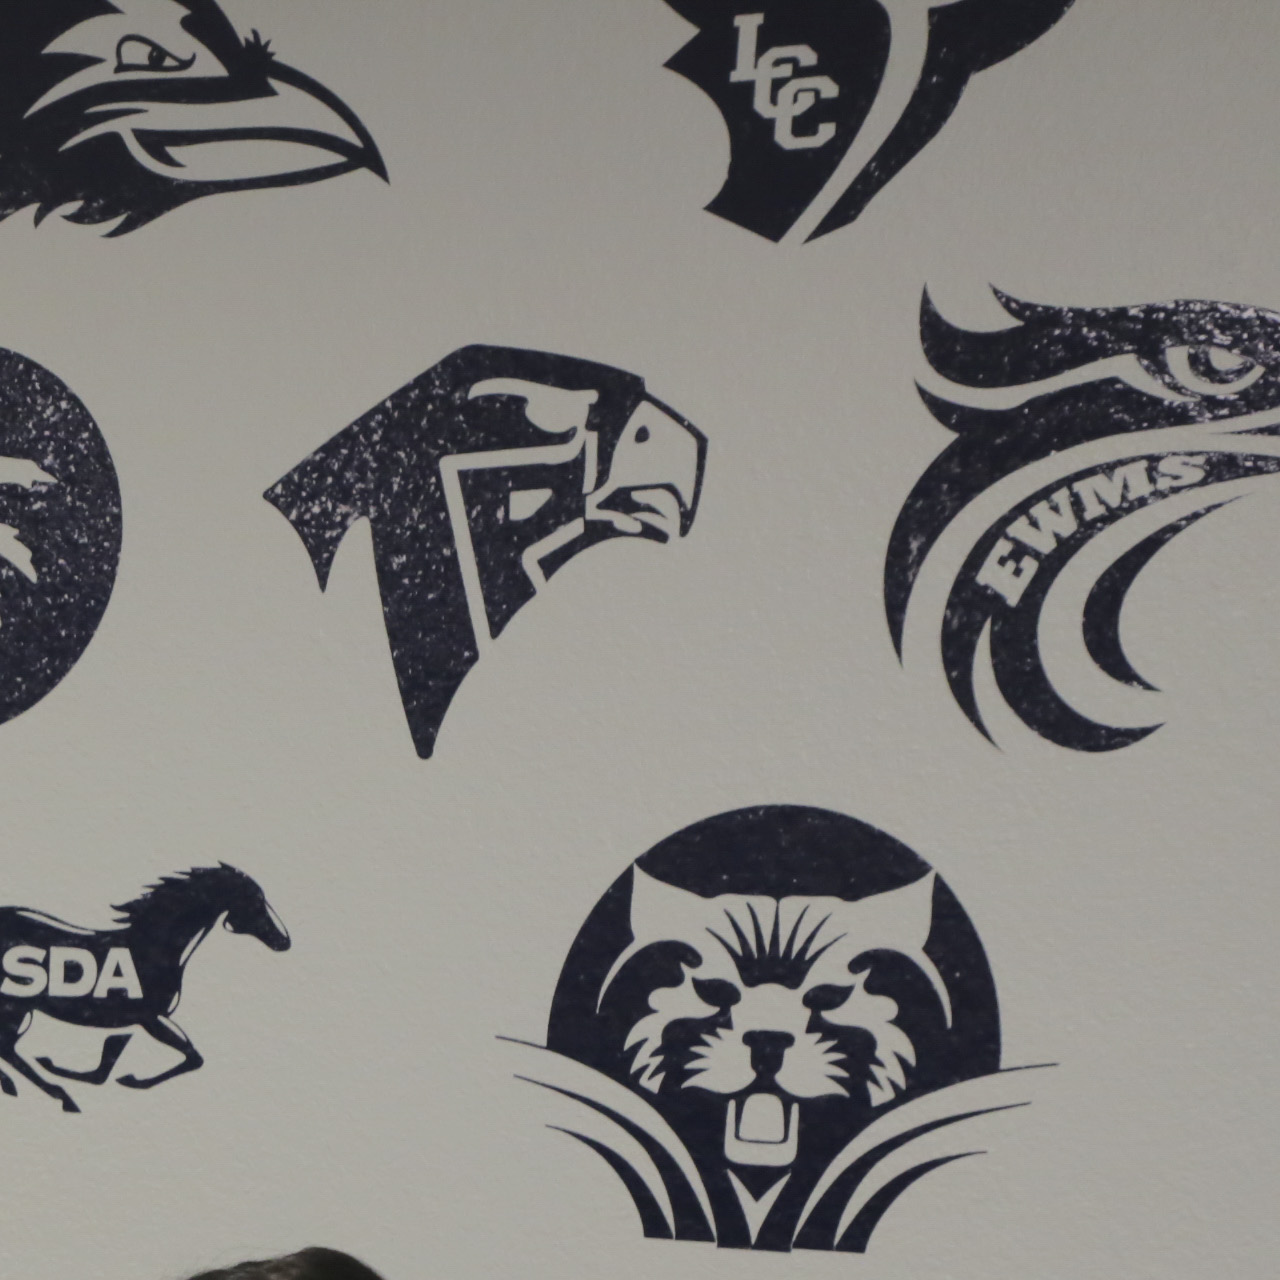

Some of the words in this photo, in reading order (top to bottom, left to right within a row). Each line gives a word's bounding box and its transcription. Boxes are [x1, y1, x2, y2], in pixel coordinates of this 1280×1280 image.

[730, 12, 839, 150] LCC
[976, 456, 1206, 606] EWMS
[0, 945, 143, 999] SDA
